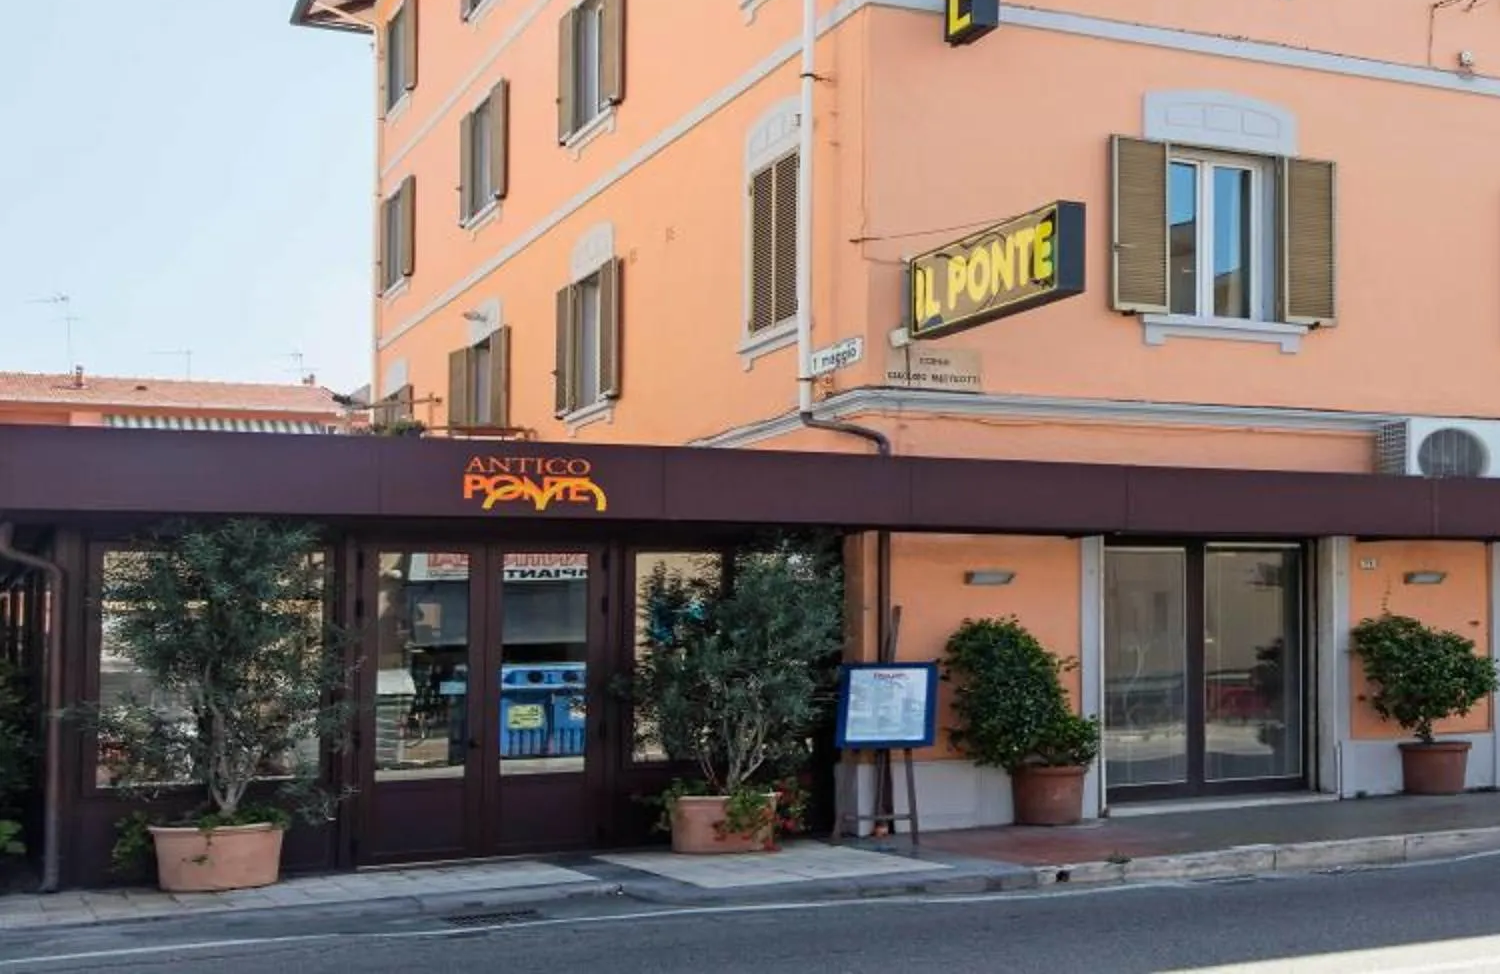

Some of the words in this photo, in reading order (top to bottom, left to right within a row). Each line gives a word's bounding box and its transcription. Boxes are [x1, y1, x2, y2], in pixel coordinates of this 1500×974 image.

[915, 266, 942, 324] IL
[947, 220, 1054, 311] PONTE
[465, 455, 592, 476] ANTICO
[463, 474, 604, 507] PONTE
